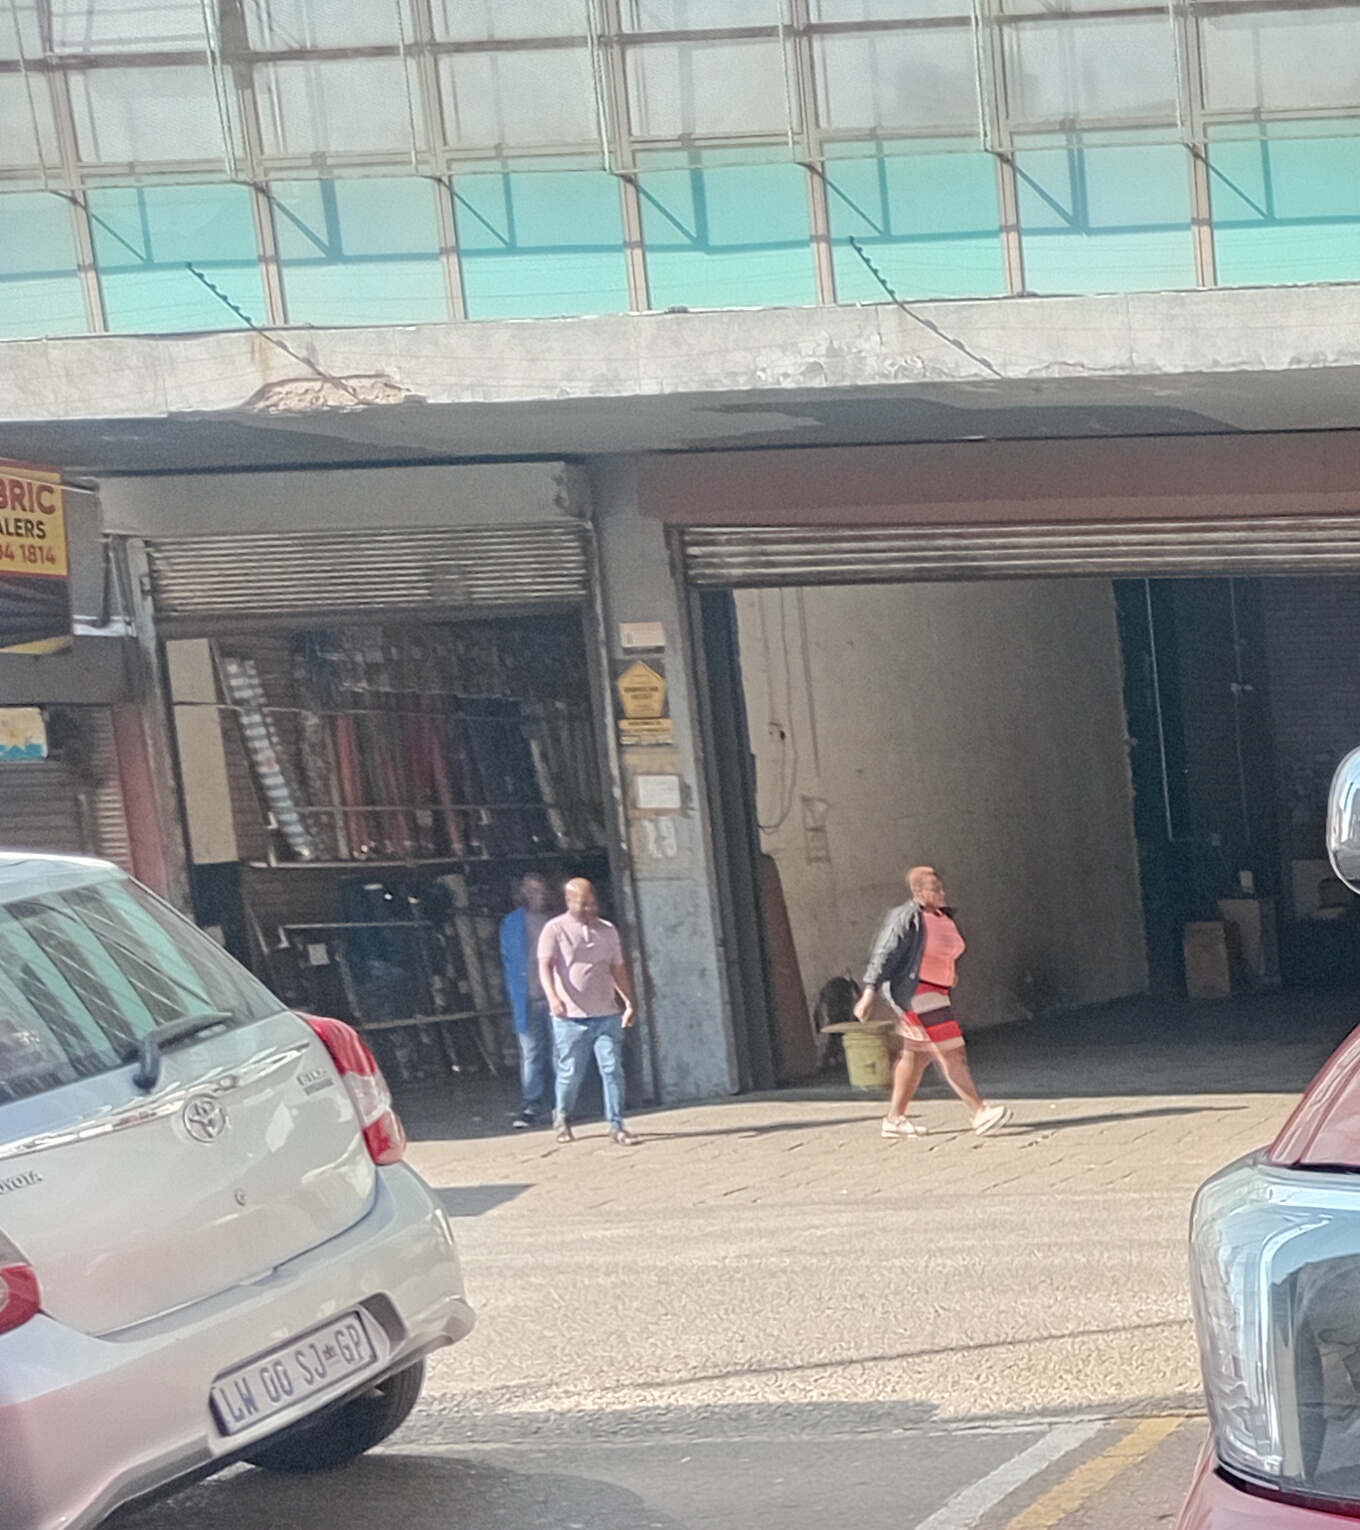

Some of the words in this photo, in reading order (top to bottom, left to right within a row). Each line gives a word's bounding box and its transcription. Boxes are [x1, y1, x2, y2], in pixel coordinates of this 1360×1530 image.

[19, 543, 57, 565] 1814
[219, 1376, 260, 1423] LW
[295, 1342, 328, 1386] SJ
[335, 1323, 365, 1365] GP
